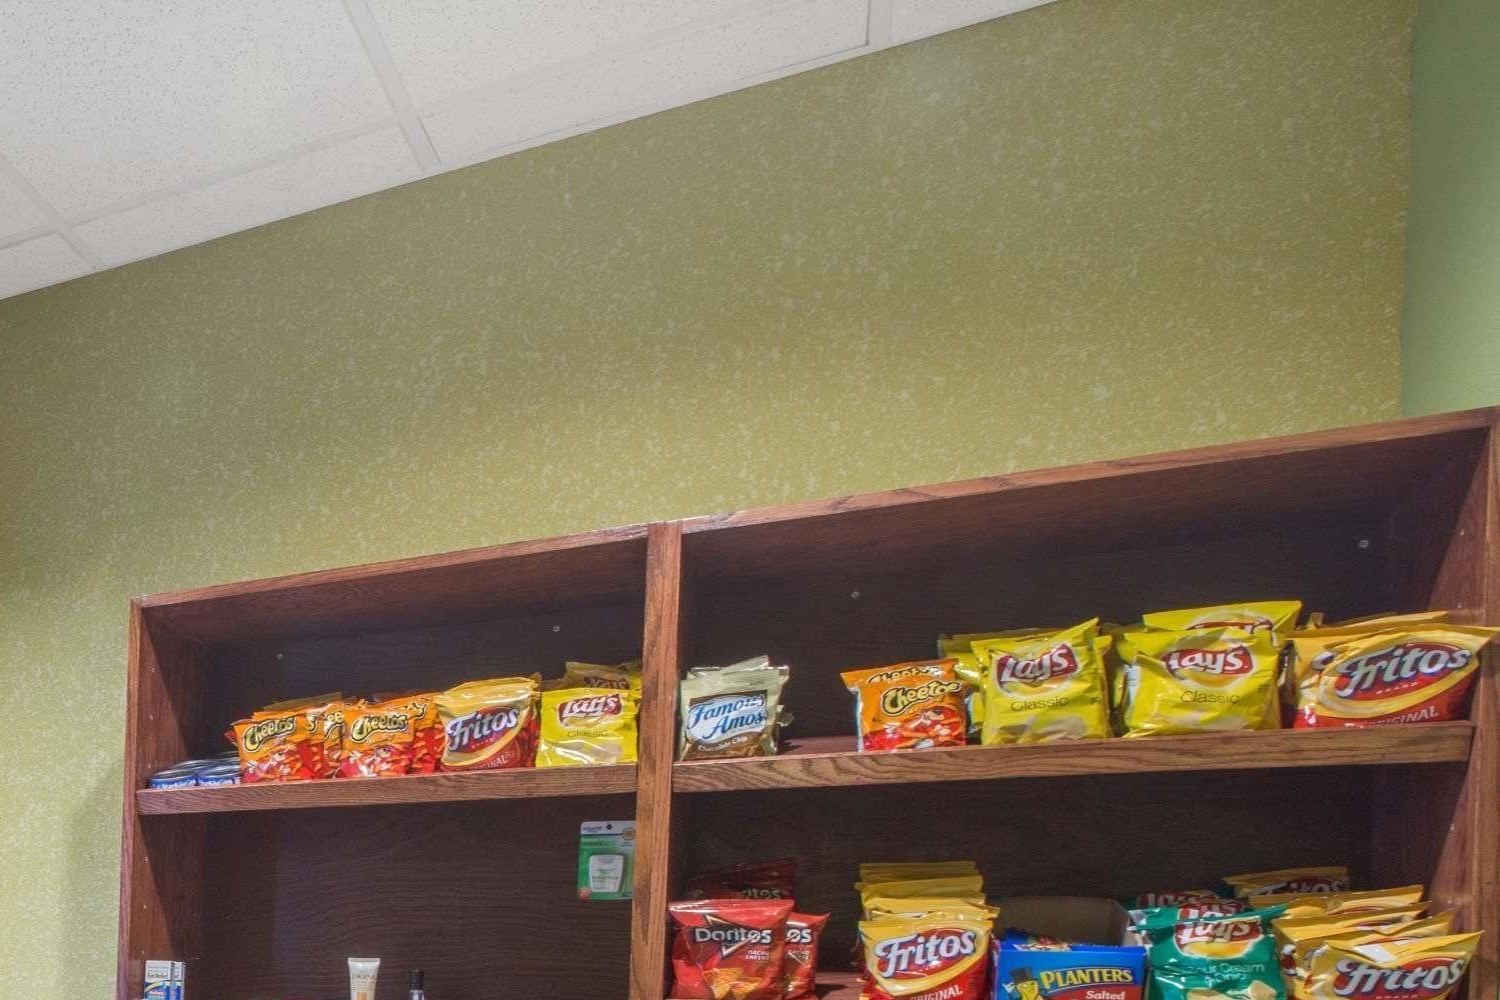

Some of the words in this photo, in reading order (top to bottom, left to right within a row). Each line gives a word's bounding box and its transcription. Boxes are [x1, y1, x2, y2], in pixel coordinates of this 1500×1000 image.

[1336, 647, 1471, 698] Fritos
[882, 681, 961, 715] Cheetos
[1011, 696, 1069, 712] Classic
[1180, 690, 1240, 704] Classic
[687, 695, 764, 729] Famous
[702, 712, 767, 739] Amos
[244, 717, 297, 752] Cheetos
[351, 713, 408, 742] Cheetos
[445, 708, 519, 751] Fritos
[694, 927, 772, 944] Doritos
[875, 931, 975, 978] Fritos
[1219, 963, 1265, 974] Cream
[1040, 967, 1134, 989] PLANTERS
[1333, 959, 1465, 996] Fritos
[1085, 990, 1126, 1000] Salted
